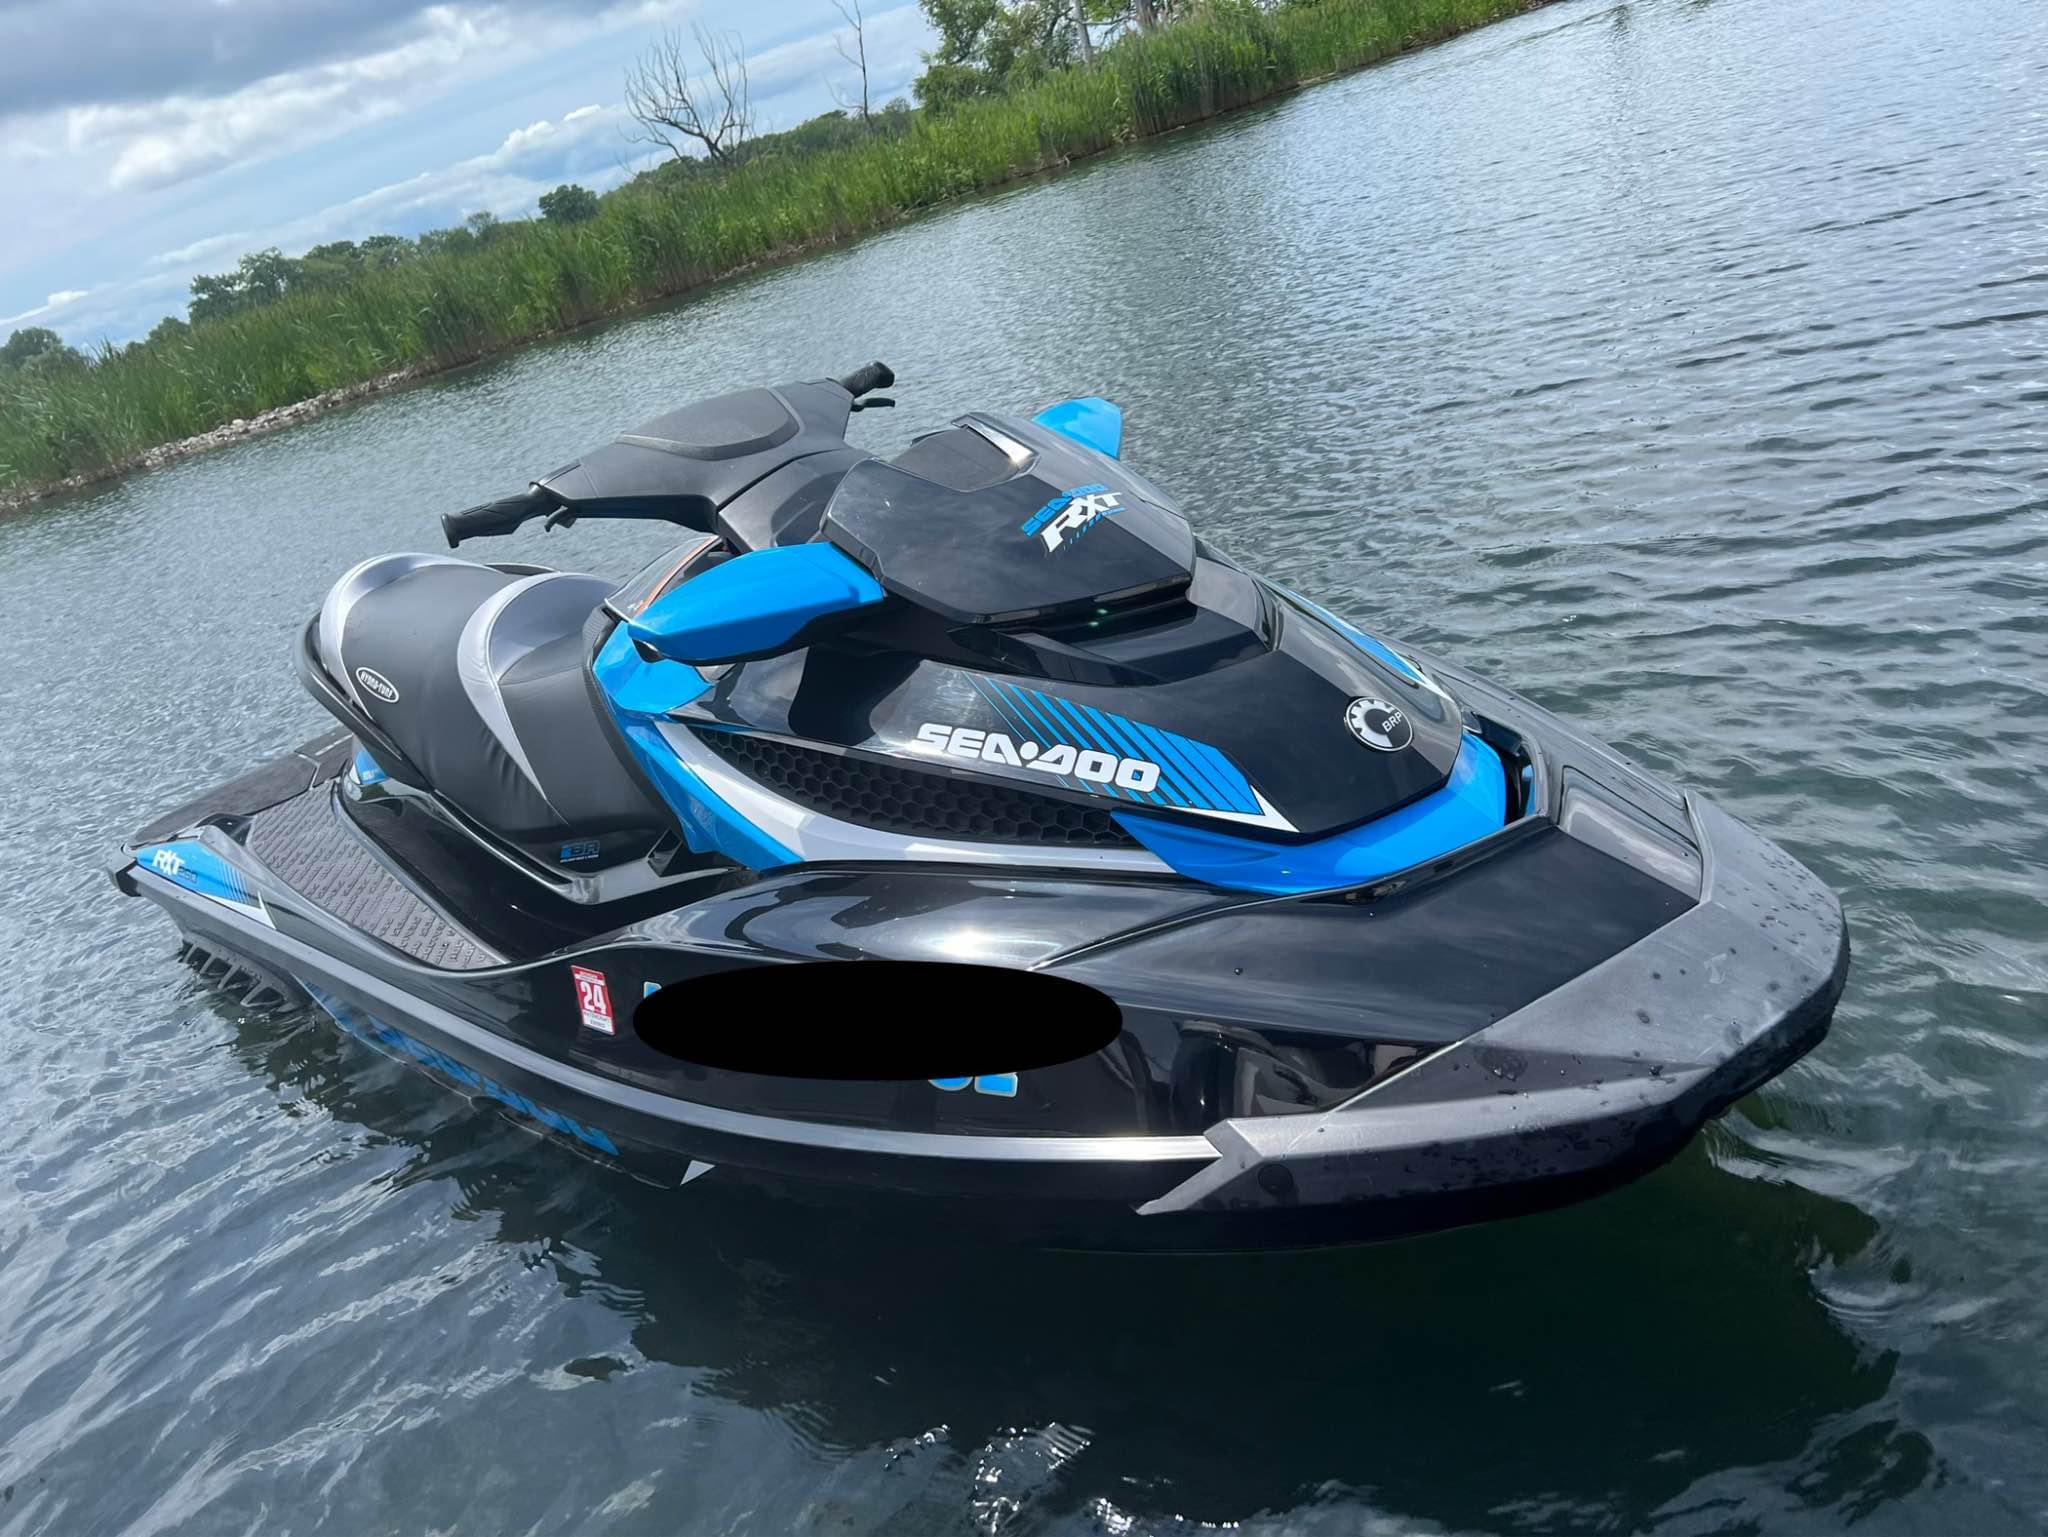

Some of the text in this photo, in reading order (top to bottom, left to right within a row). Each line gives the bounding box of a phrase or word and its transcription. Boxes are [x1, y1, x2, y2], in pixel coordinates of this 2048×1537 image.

[1040, 491, 1122, 552] RXT
[1382, 711, 1402, 732] BRP
[152, 849, 185, 876] RXT
[580, 981, 607, 1015] 24
